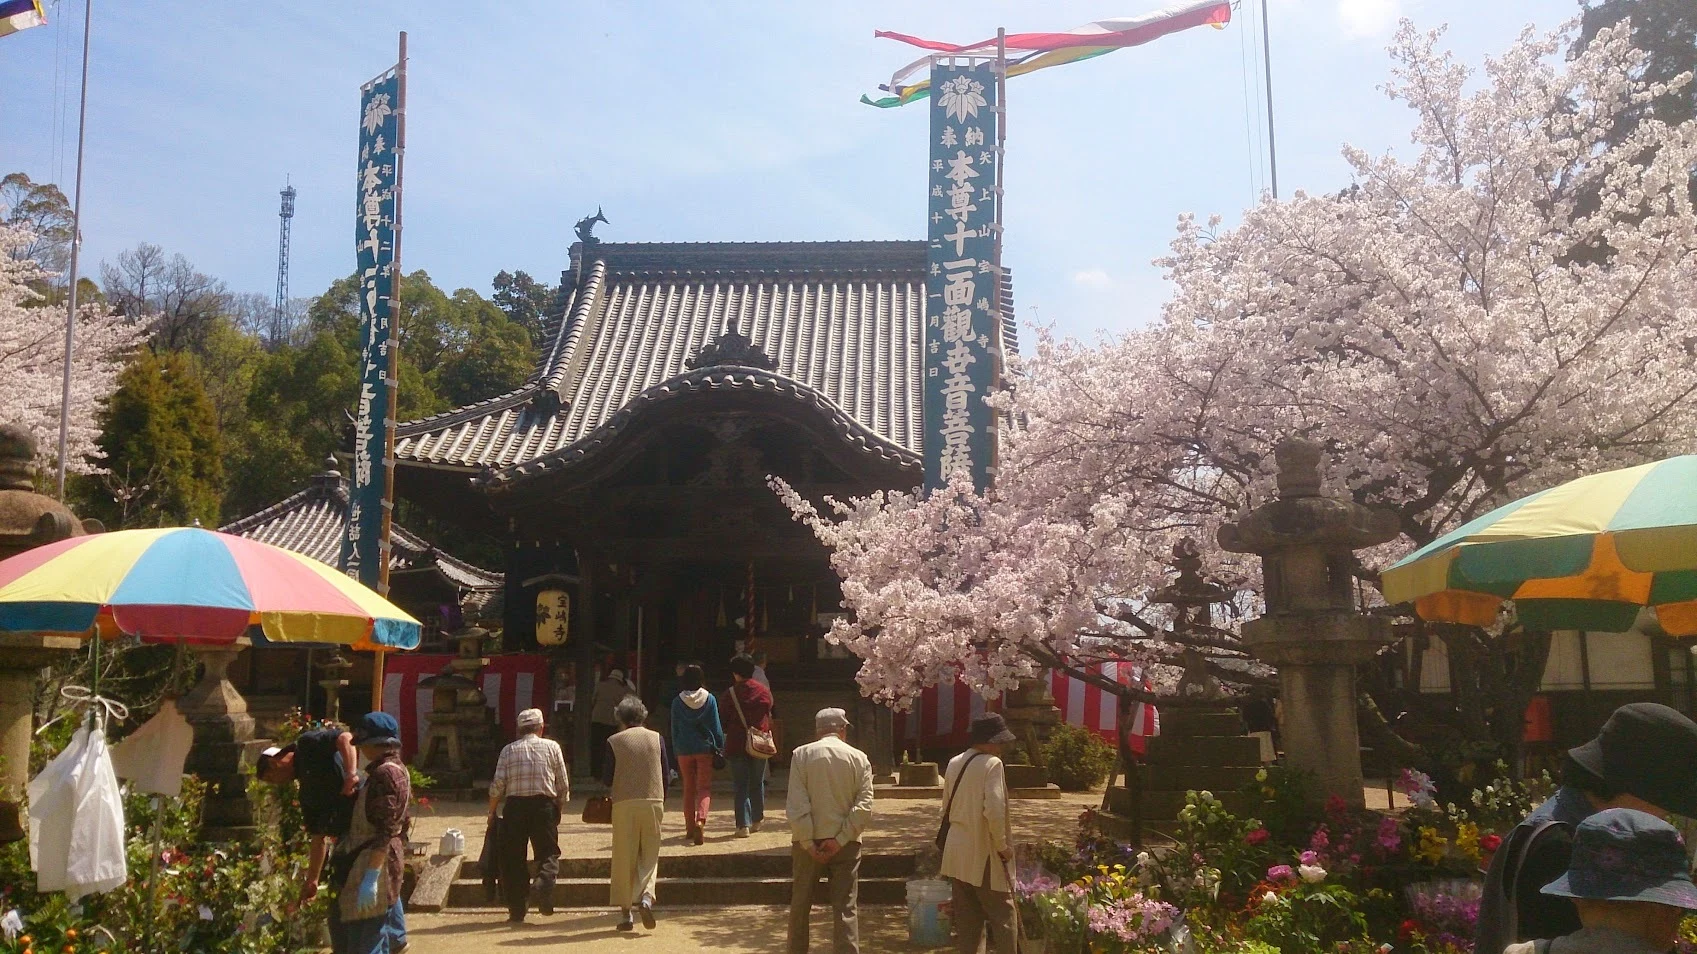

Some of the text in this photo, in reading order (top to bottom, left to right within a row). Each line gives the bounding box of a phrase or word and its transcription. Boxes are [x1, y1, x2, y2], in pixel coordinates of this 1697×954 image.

[940, 125, 984, 147] 奉納
[928, 159, 944, 378] 平成十二年一月吉日
[553, 595, 568, 641] 宝嶋寺
